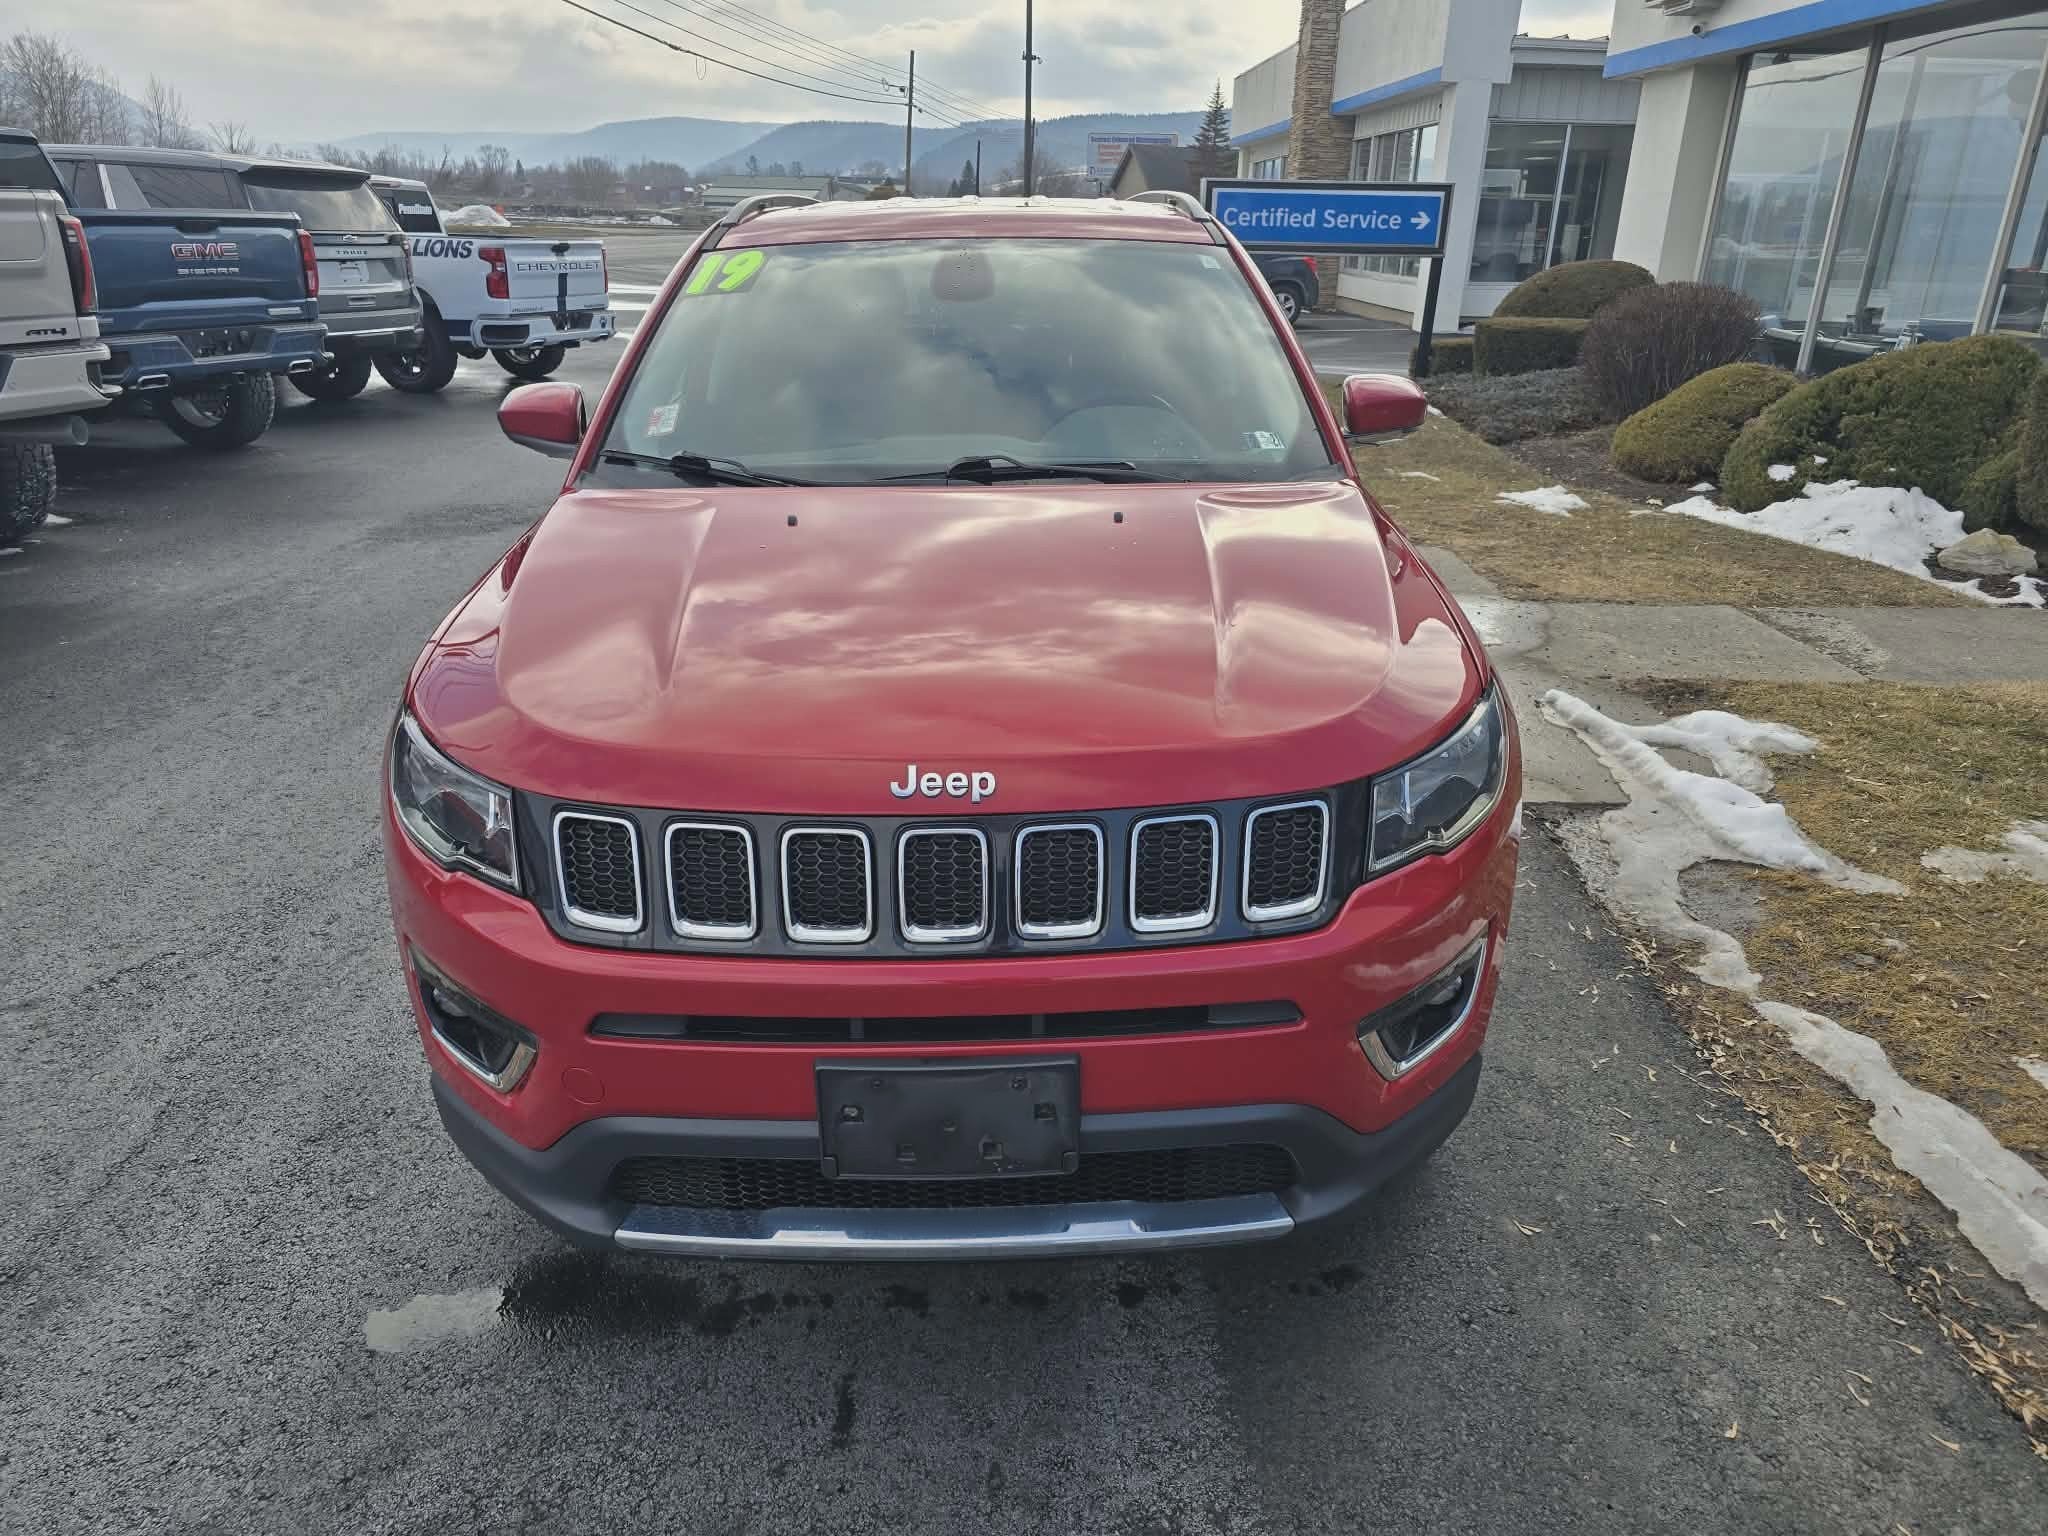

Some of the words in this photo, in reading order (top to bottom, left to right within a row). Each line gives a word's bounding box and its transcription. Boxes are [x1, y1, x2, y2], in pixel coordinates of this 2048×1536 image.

[1223, 207, 1316, 228] Certified
[1323, 208, 1402, 230] Service
[170, 243, 240, 260] GMC
[411, 239, 474, 259] LIONS
[516, 262, 600, 272] CHEVROLET
[685, 250, 765, 295] 19
[890, 764, 997, 803] Jeep
